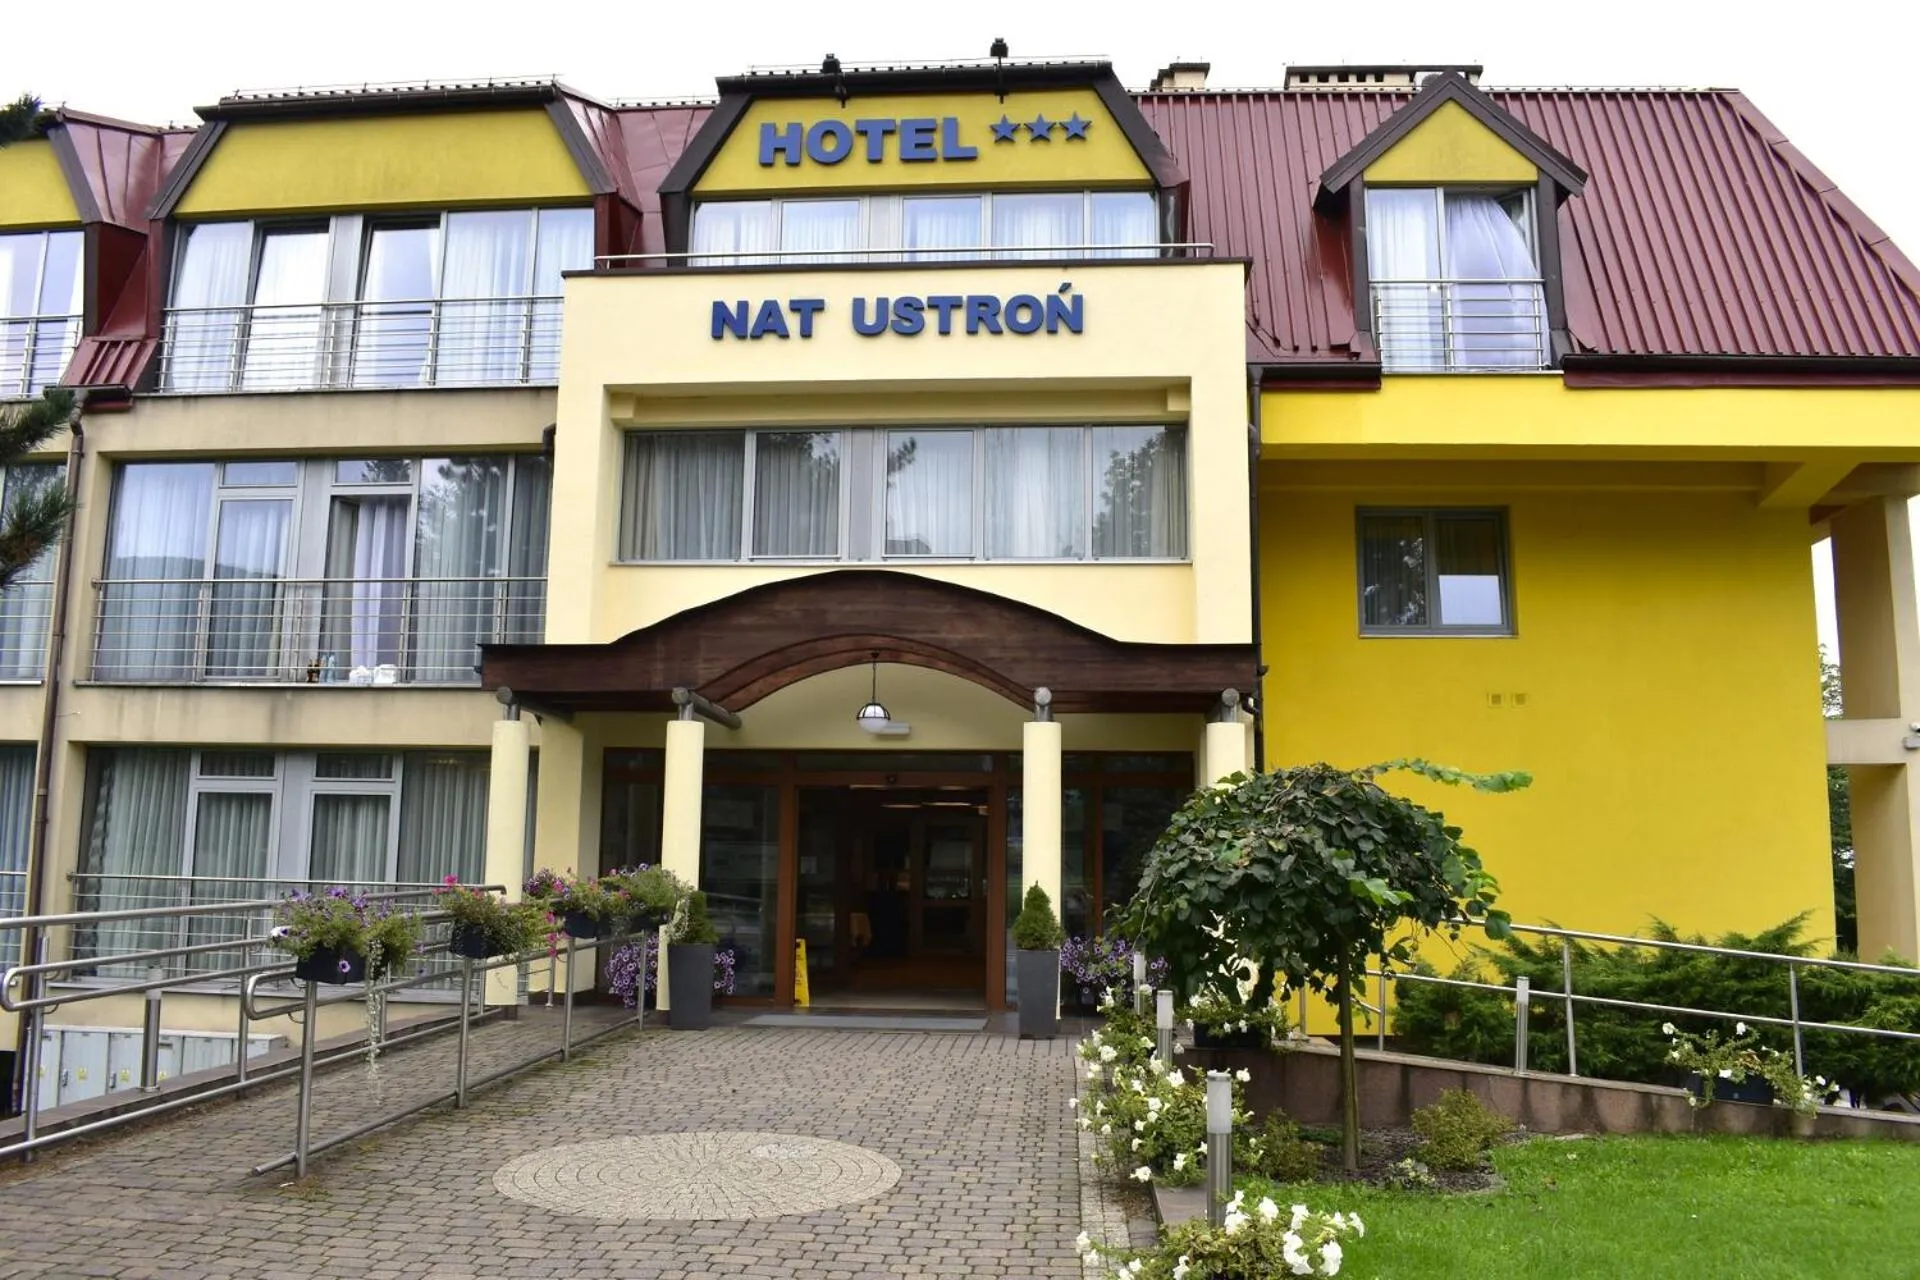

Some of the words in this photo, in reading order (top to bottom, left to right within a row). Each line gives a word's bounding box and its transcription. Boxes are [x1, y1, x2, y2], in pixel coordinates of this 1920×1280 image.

[759, 117, 979, 167] HOTEL
[711, 299, 826, 339] NAT
[852, 282, 1085, 337] USTROŃ
